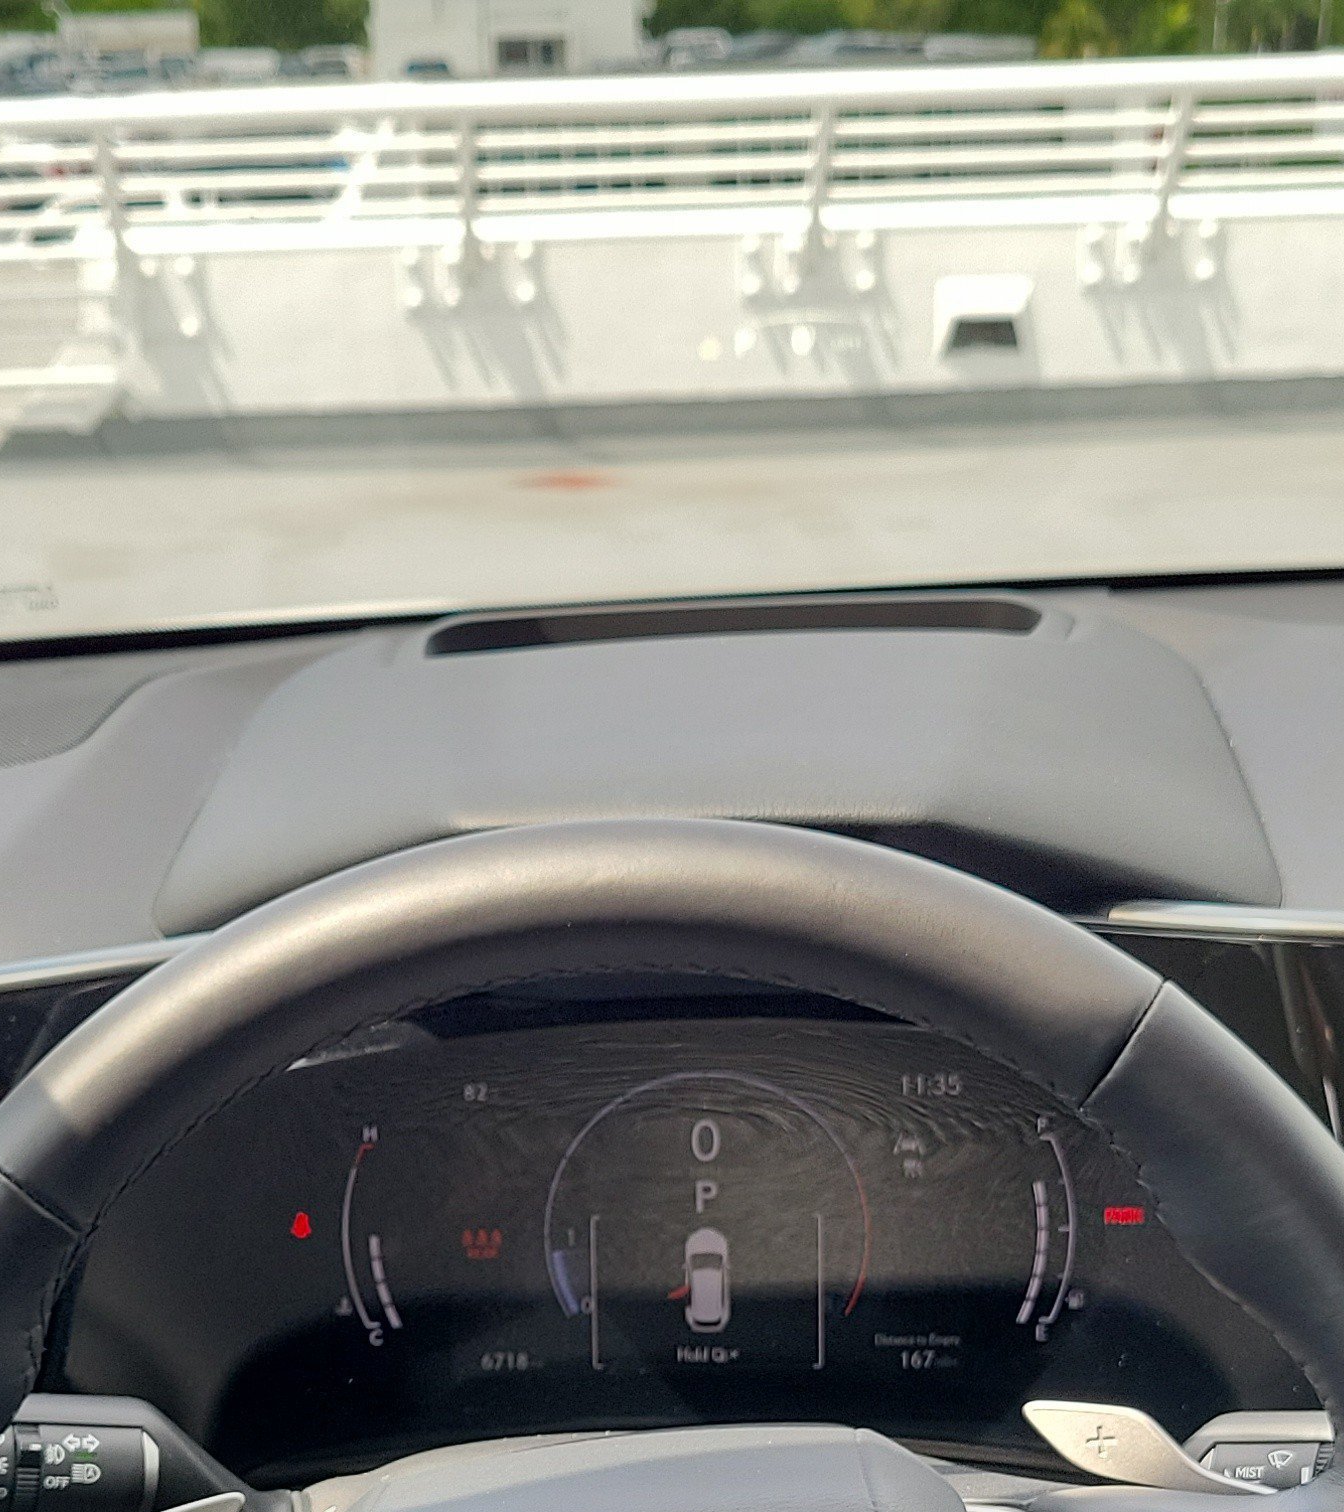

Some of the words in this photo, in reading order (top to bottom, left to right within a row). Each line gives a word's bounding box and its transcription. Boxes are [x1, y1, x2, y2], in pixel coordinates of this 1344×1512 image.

[901, 1074, 962, 1095] 11:35
[691, 1118, 721, 1162] 0
[695, 1180, 718, 1213] P
[481, 1352, 529, 1371] 6718
[901, 1351, 934, 1369] 167
[1235, 1465, 1265, 1479] MIST
[43, 1476, 69, 1490] OFF
